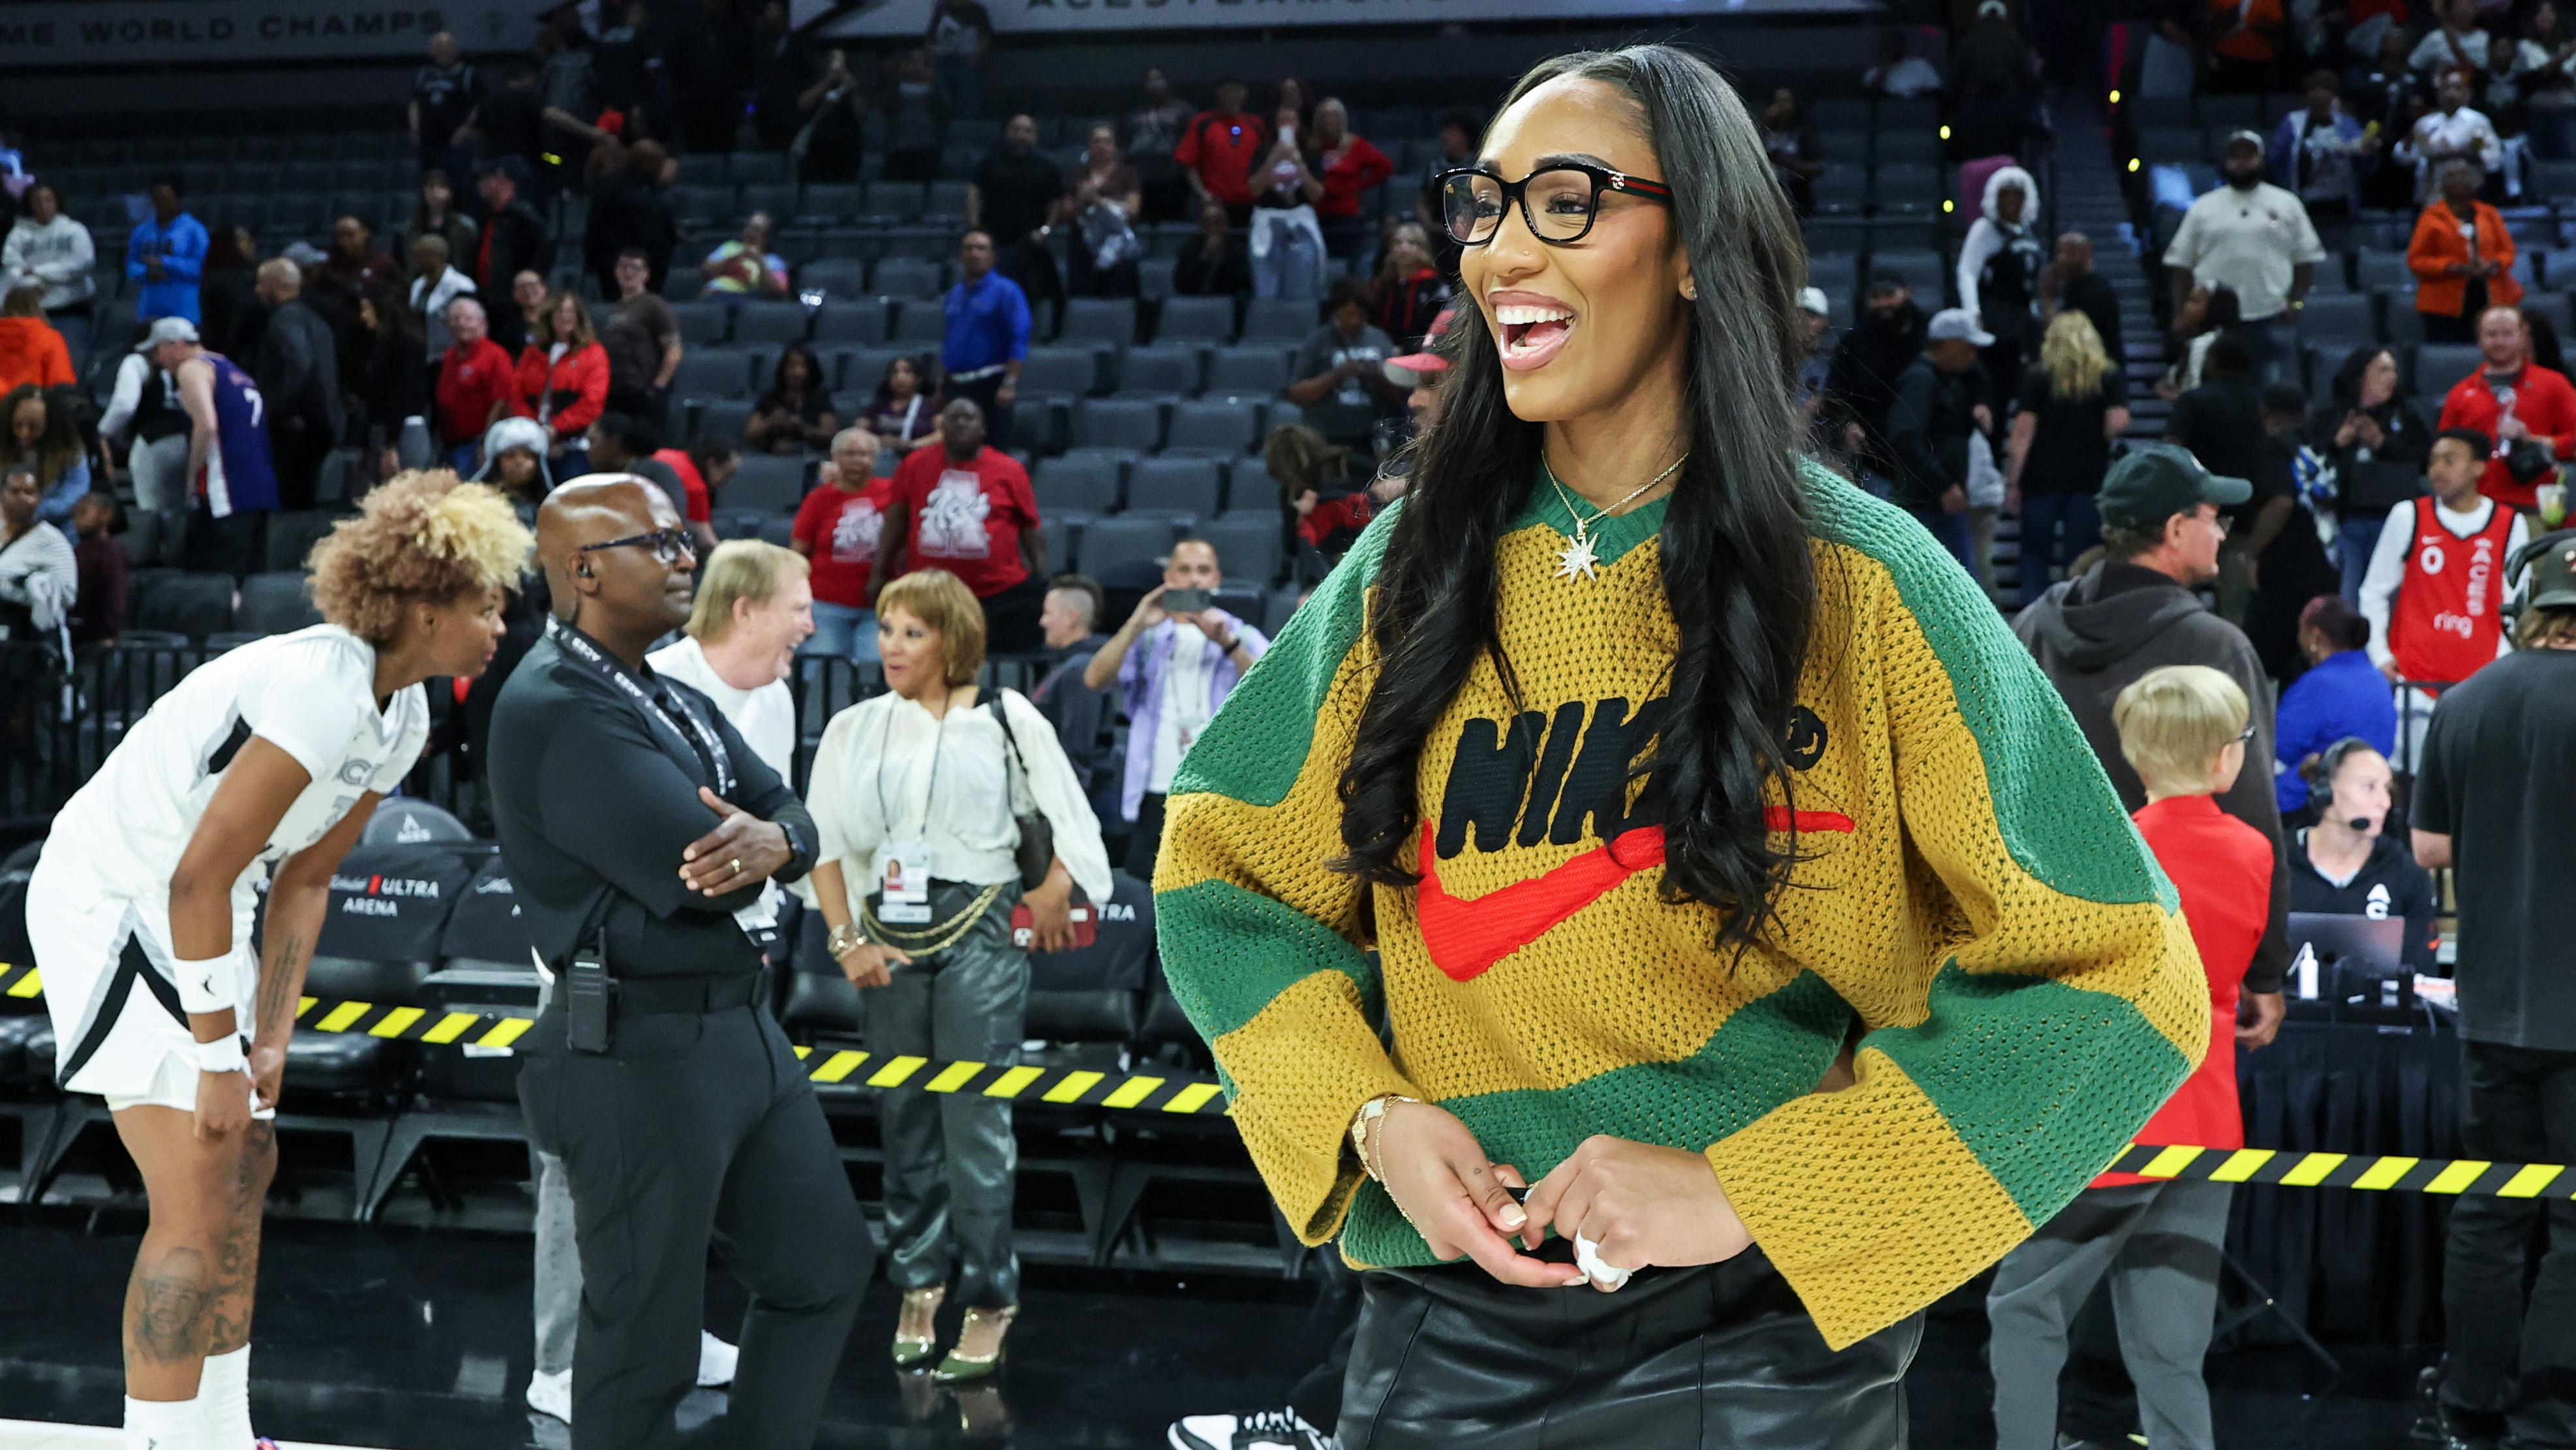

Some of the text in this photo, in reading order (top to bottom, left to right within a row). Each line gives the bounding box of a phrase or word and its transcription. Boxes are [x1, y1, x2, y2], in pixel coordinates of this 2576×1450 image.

[81, 17, 234, 44] WORLD
[257, 10, 443, 39] CHAMPS
[243, 387, 264, 427] 7
[2420, 545, 2445, 575] 0
[2434, 610, 2473, 639] ring
[1436, 696, 1670, 860] NIK
[381, 877, 440, 898] ULTRA
[342, 897, 398, 917] ARENA
[1097, 903, 1136, 921] TRA
